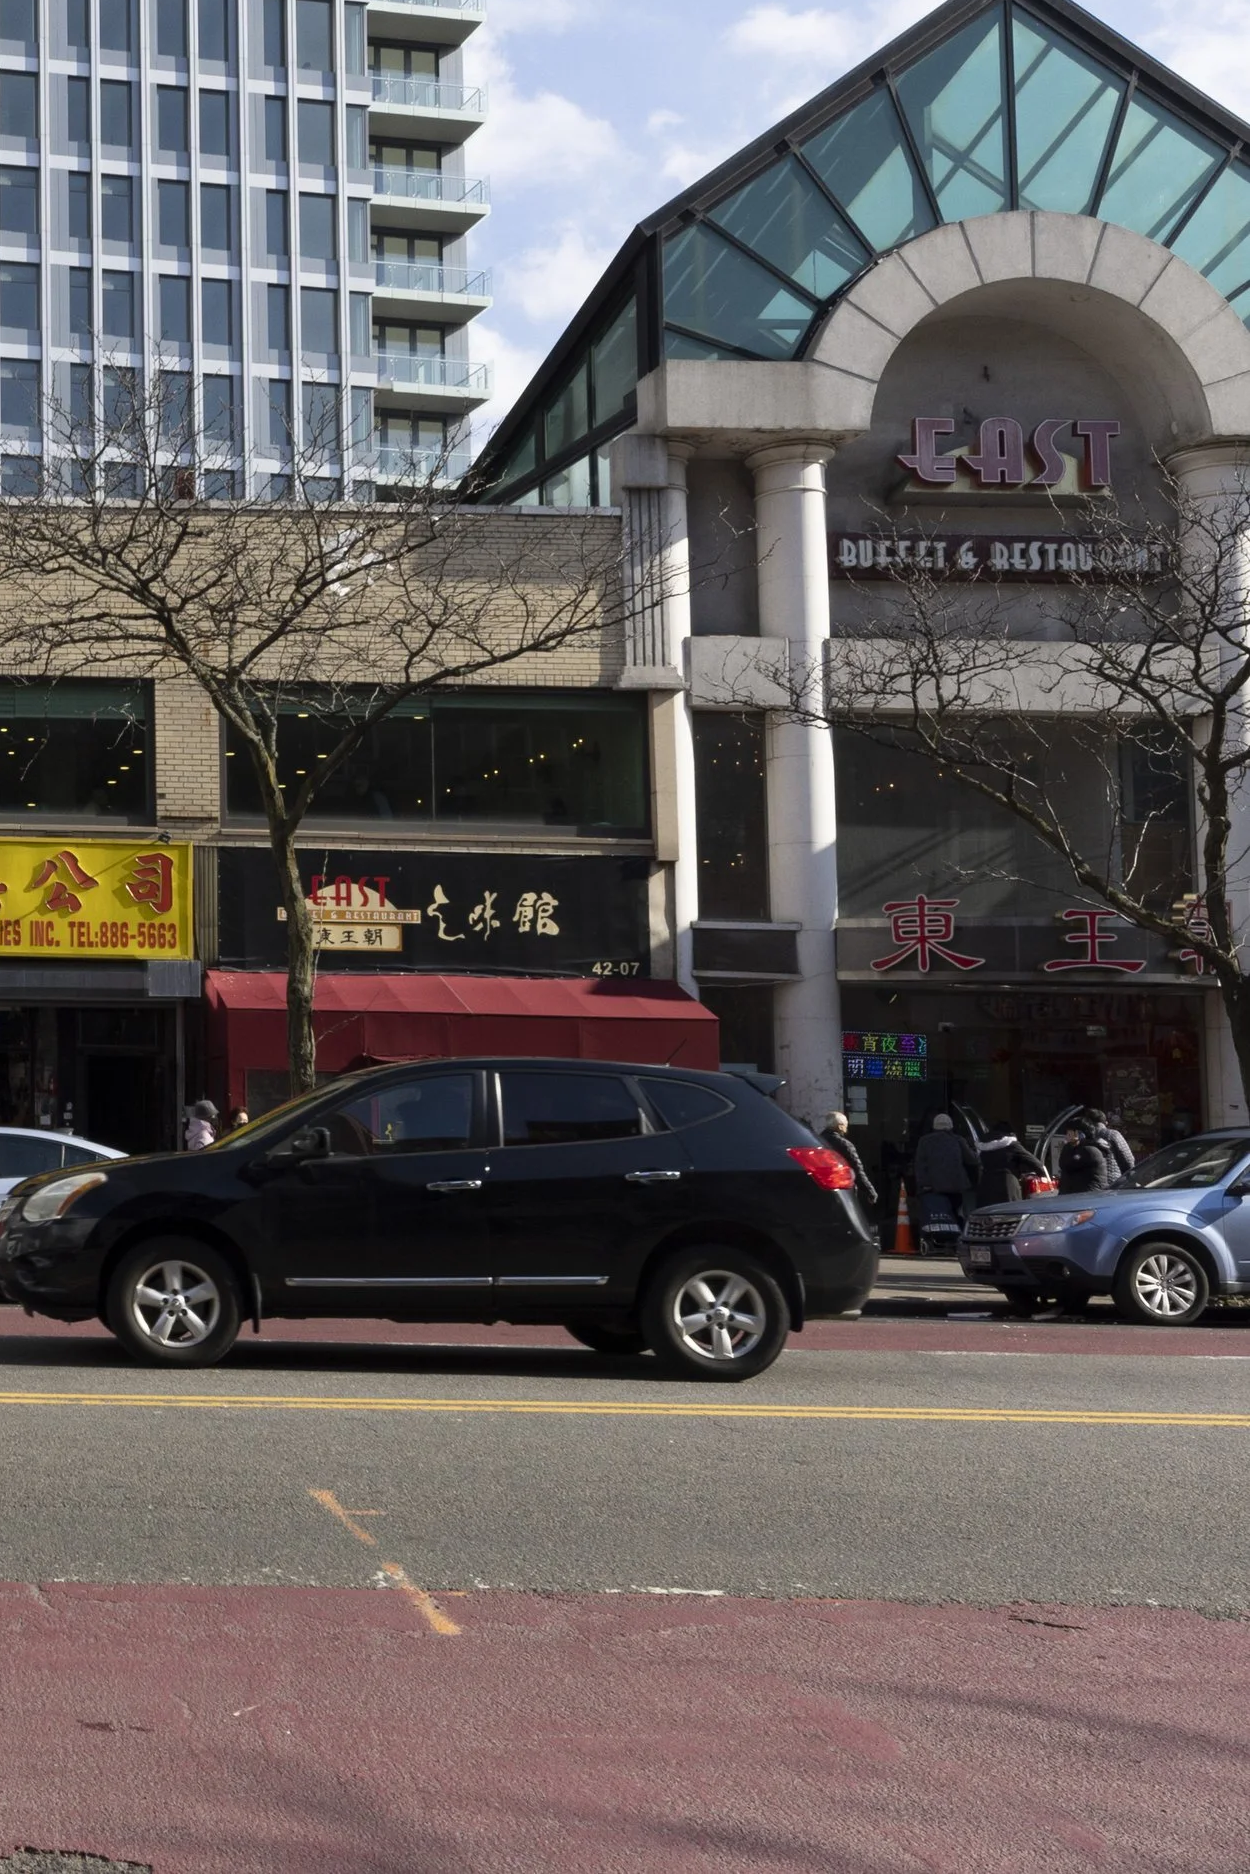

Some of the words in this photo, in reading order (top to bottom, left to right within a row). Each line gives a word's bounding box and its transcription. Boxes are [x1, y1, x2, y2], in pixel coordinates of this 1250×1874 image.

[897, 416, 1121, 486] EAST
[958, 540, 979, 570] &
[308, 874, 390, 907] EAST
[345, 911, 418, 922] RESTAURANT
[29, 920, 60, 947] INC.
[592, 962, 640, 975] 42-07
